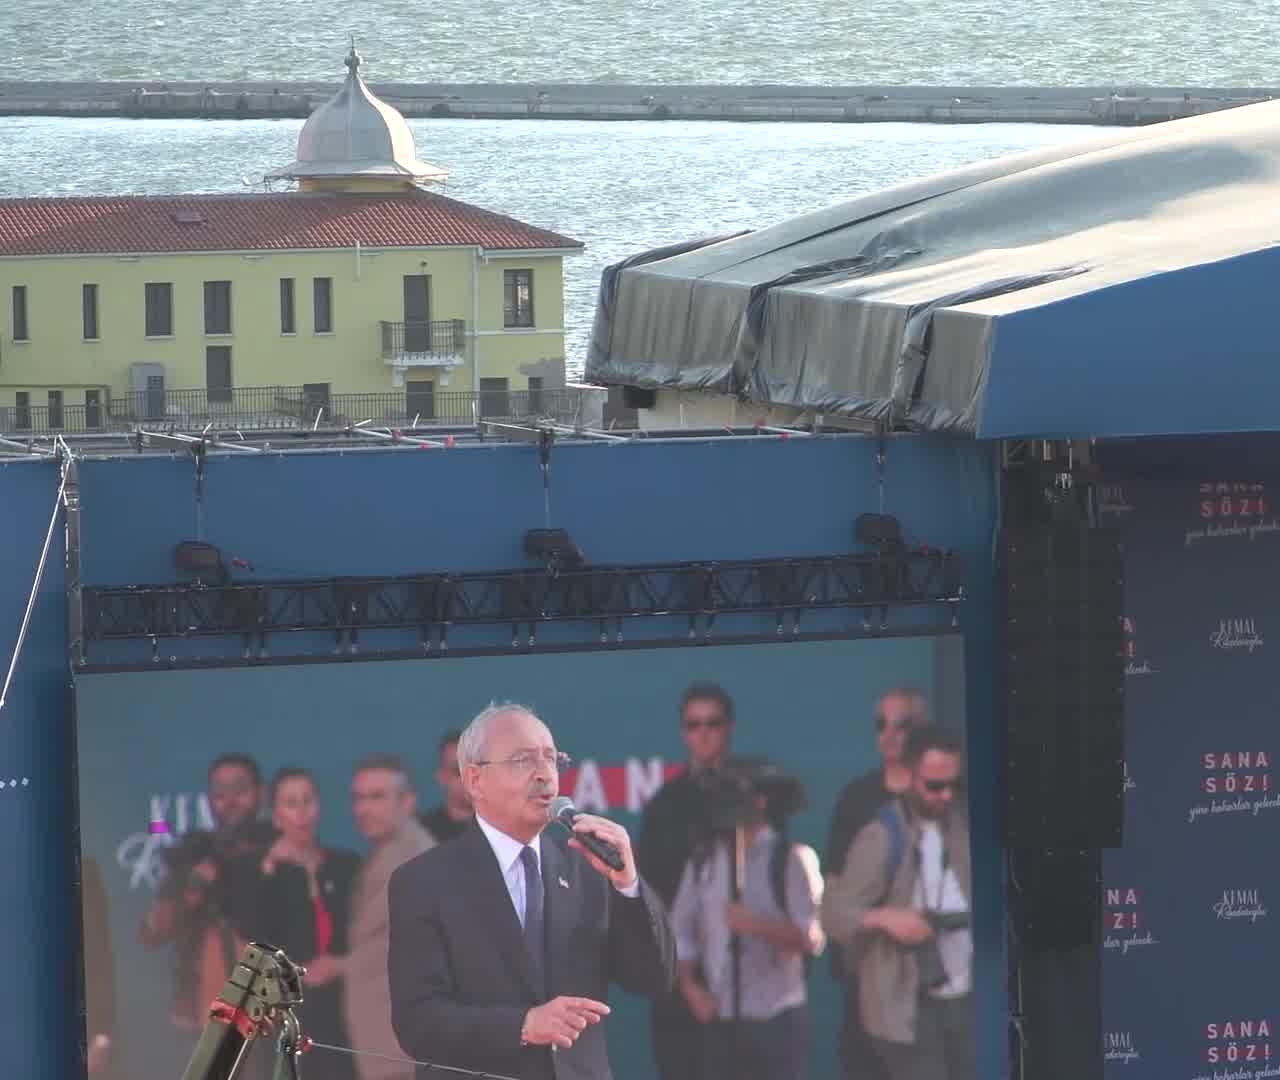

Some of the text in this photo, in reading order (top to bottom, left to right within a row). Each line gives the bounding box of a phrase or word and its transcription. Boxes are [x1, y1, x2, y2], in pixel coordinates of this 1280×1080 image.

[1205, 751, 1268, 769] SANA
[573, 759, 665, 813] AN
[1206, 772, 1267, 793] SÖZ!
[1207, 1020, 1269, 1039] SANA
[1208, 1042, 1269, 1063] SÖZ!
